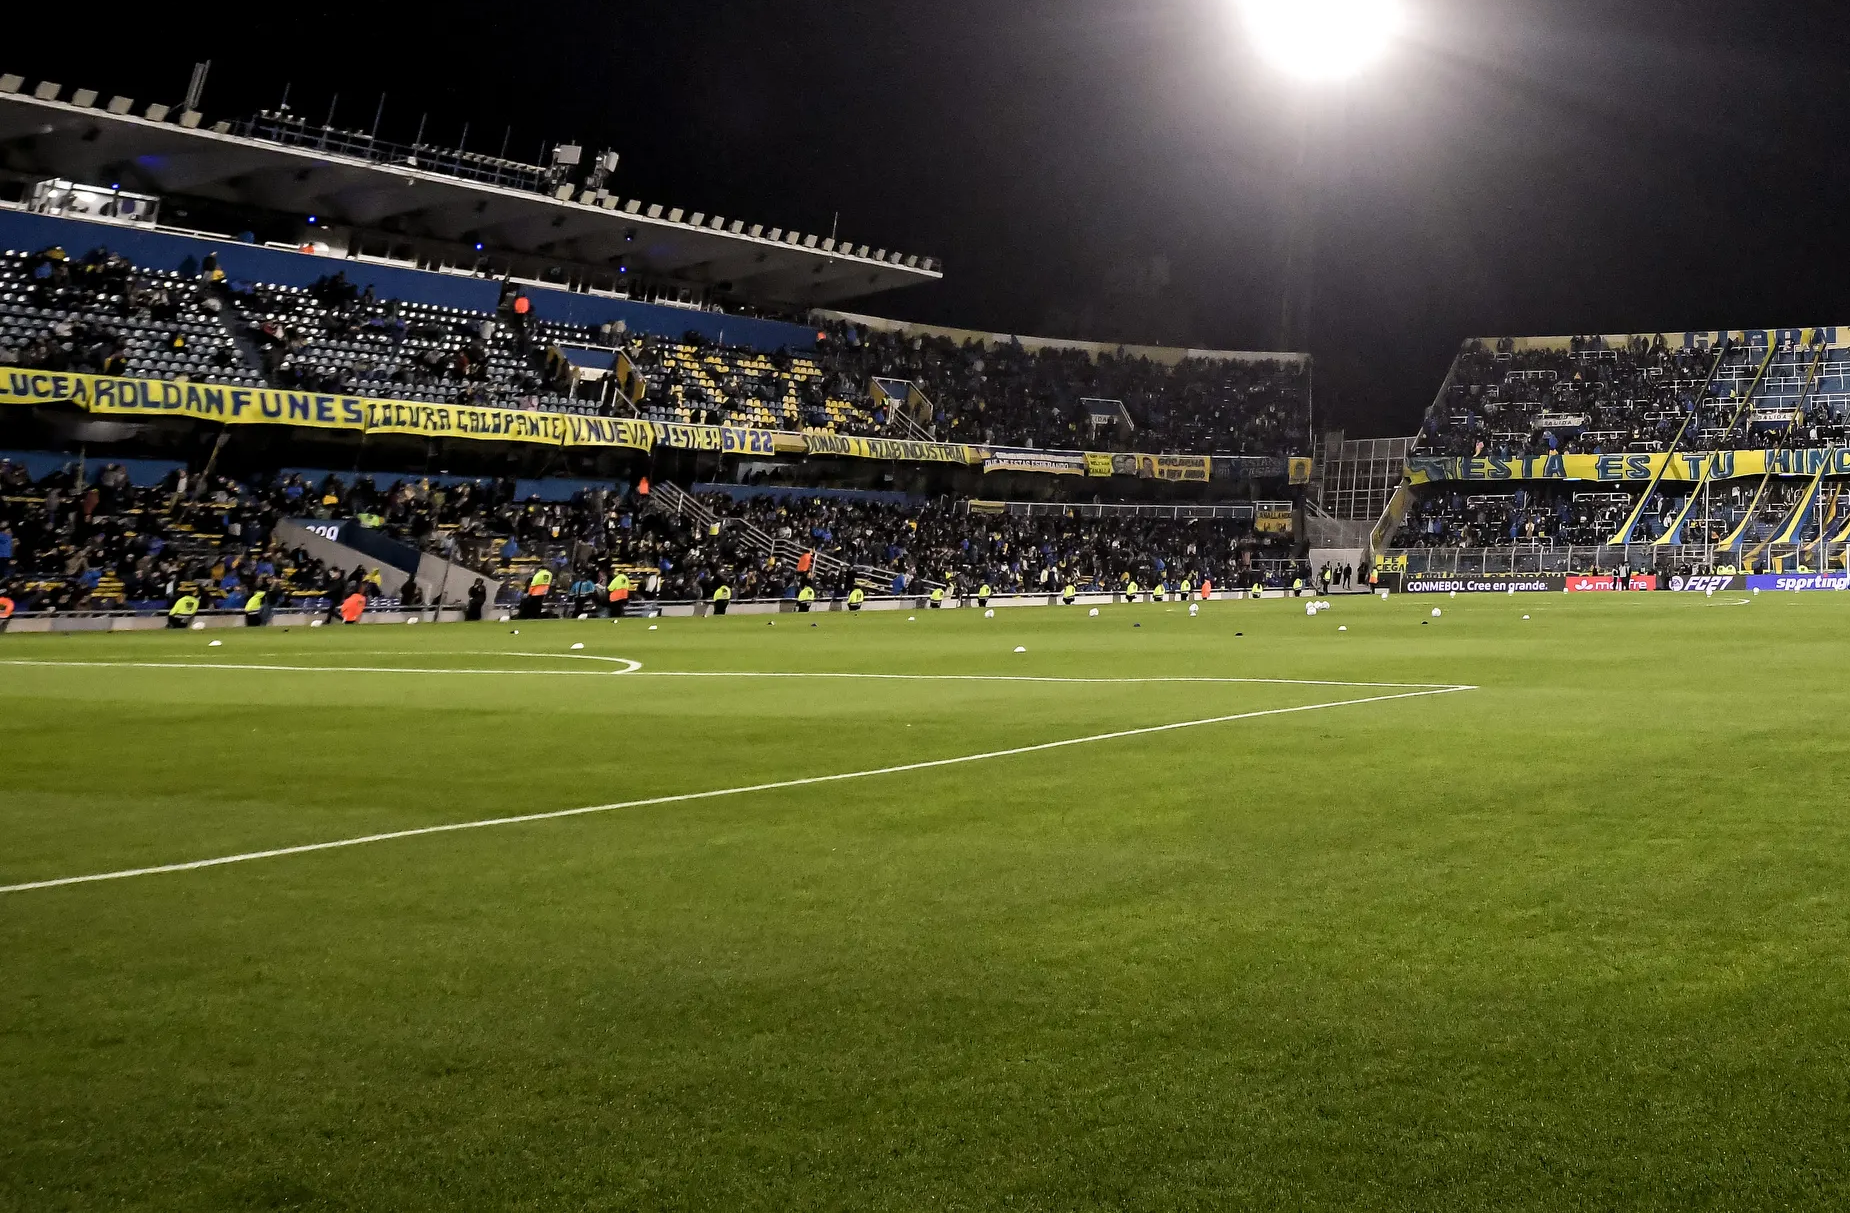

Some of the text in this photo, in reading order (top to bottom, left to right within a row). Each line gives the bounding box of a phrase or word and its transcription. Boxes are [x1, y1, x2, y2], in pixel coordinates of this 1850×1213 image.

[94, 378, 224, 416] ROLDAN
[230, 390, 363, 424] FUNES
[367, 403, 561, 440] LOCURA GALOPANTE
[1460, 454, 1568, 479] ESTA
[1596, 454, 1650, 479] ES
[1682, 451, 1735, 479] TU
[1377, 564, 1405, 572] CIEGA
[1383, 556, 1399, 564] FE
[1407, 580, 1465, 592] CONMEBOL
[1467, 580, 1492, 591] Cree
[1493, 582, 1507, 591] en
[1683, 576, 1733, 590] FC27
